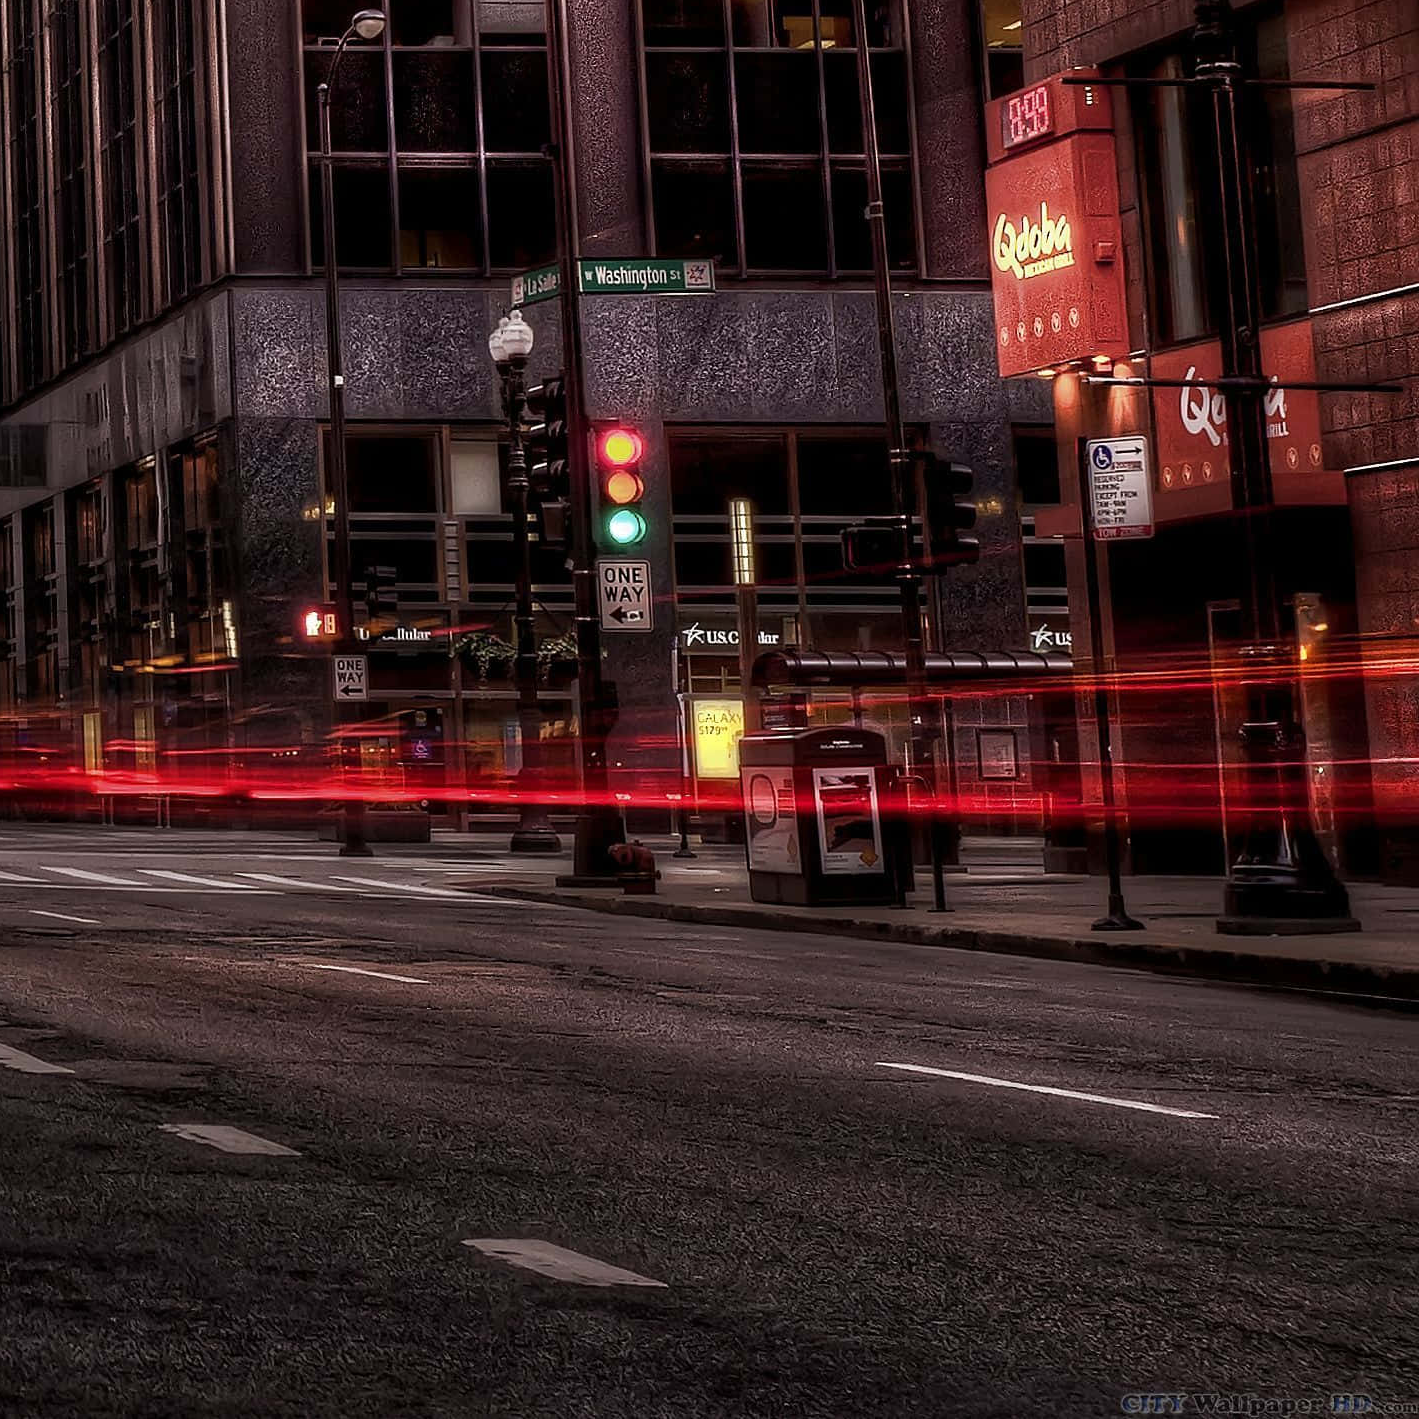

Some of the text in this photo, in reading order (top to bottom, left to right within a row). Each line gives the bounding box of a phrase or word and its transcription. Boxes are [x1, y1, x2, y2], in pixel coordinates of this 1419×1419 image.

[993, 201, 1072, 279] Qdoba
[584, 266, 682, 290] W Washington St
[604, 568, 643, 583] ONE
[604, 586, 644, 602] WAY
[337, 660, 363, 671] ONE
[337, 672, 364, 683] WAY
[698, 712, 742, 724] GALAXY
